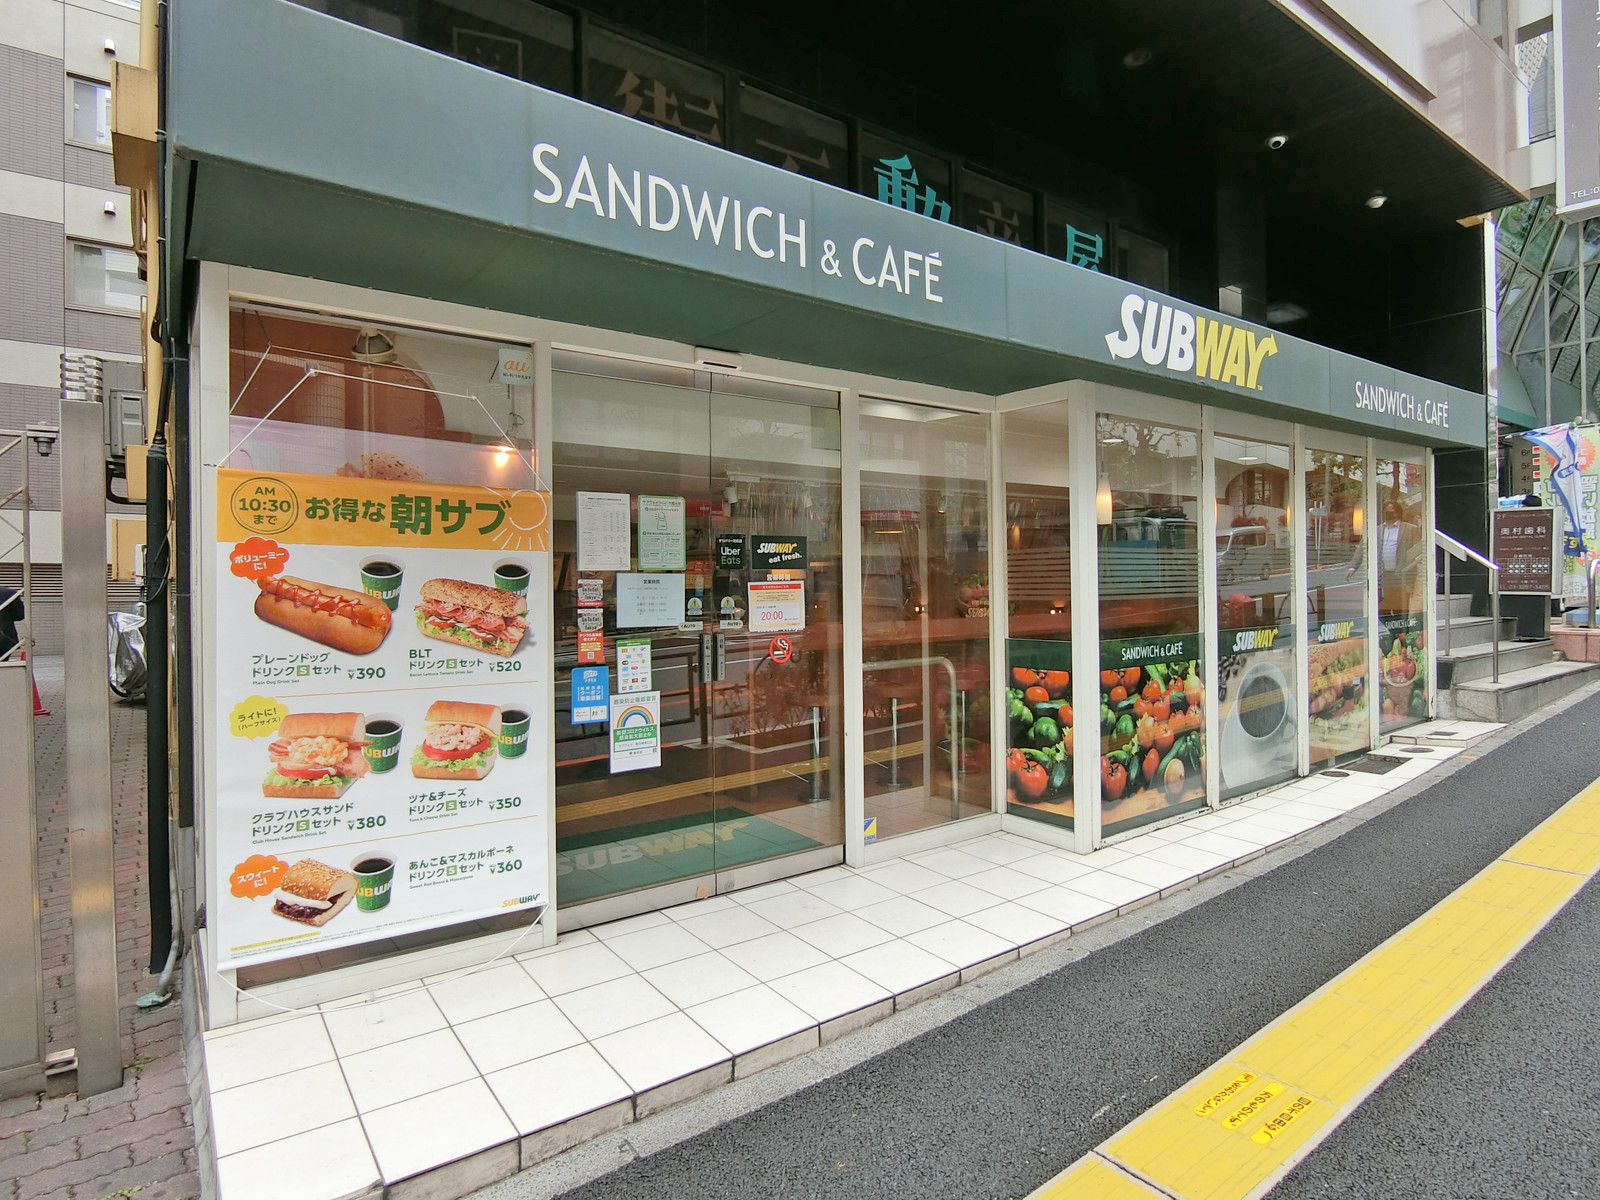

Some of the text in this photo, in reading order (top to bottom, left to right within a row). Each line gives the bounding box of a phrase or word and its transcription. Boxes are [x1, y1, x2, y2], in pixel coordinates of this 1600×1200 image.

[531, 142, 808, 269] SANDWICH
[820, 239, 843, 279] &
[852, 237, 944, 304] CAFÉ
[1104, 294, 1279, 391] SUBWAY
[504, 360, 528, 372] au
[1355, 381, 1449, 428] SANDWICH & CAFÉ
[255, 486, 276, 496] AM
[239, 498, 292, 513] 10:30
[253, 514, 278, 526] まで
[304, 493, 512, 536] お得な朝サブ
[1500, 526, 1546, 536] 奥村歯科
[720, 546, 741, 556] Uber
[756, 542, 798, 554] SUBWAY
[721, 556, 741, 565] Eats
[768, 556, 781, 564] eat
[761, 610, 784, 621] 20:00
[1318, 621, 1354, 642] SUBWAY
[1232, 627, 1279, 652] SUBWAY
[409, 649, 432, 659] BLT
[1121, 645, 1160, 660] SANDWICH
[1165, 641, 1184, 656] CAFÉ
[252, 652, 331, 665] プレーンドッグ
[409, 787, 467, 804] ツナ&チーズ
[252, 802, 354, 825] クラブハウスサンド
[557, 821, 749, 876] SUBWAY
[409, 845, 515, 871] あんこ&マスカルポーネ
[501, 893, 541, 908] SUBWAY
